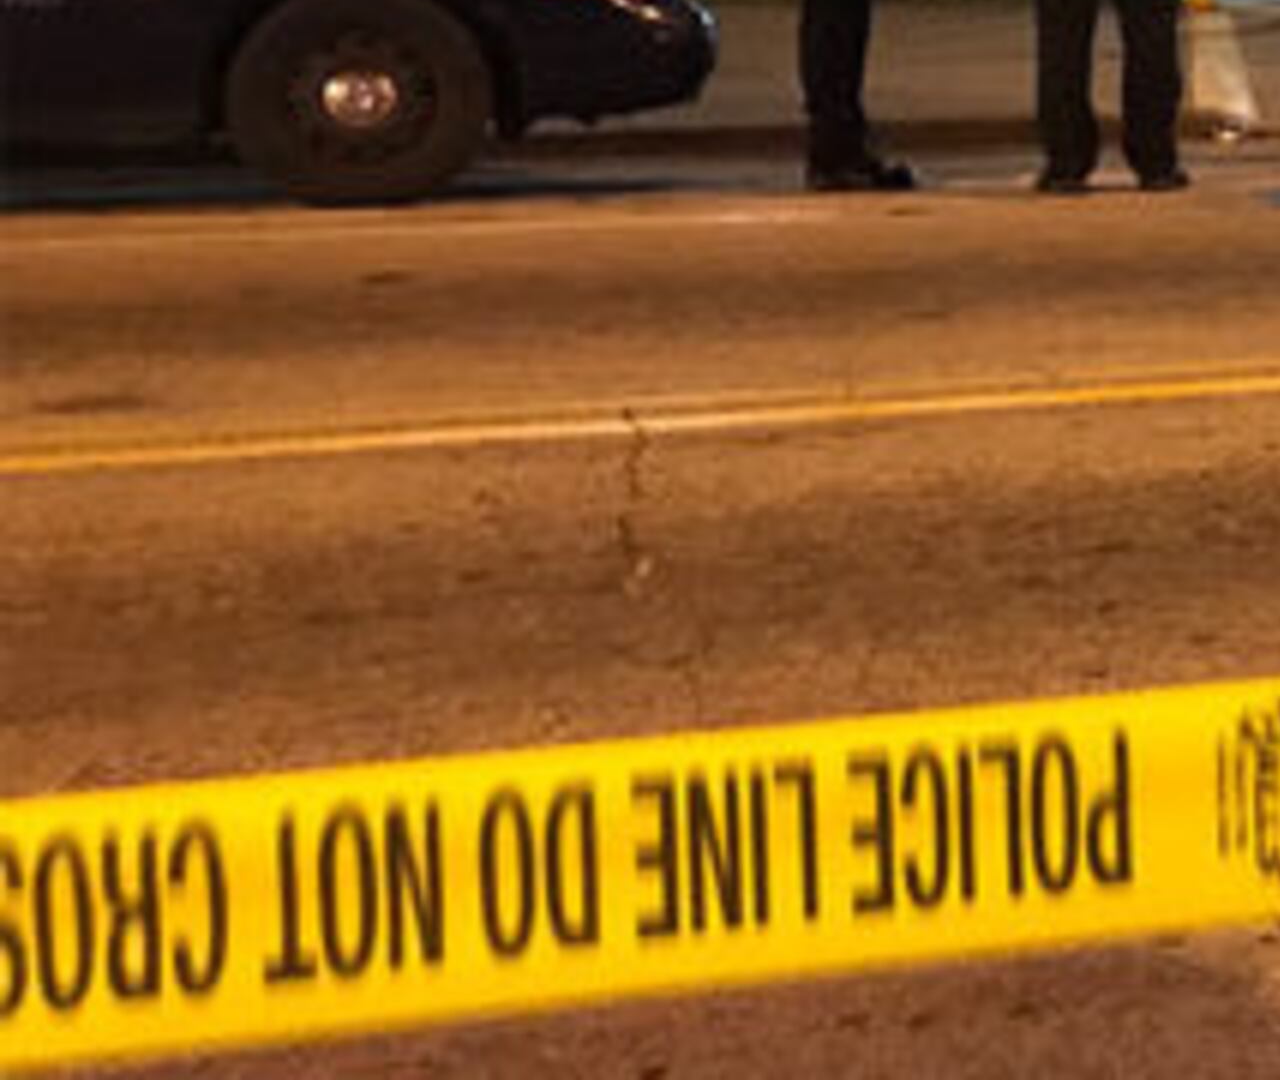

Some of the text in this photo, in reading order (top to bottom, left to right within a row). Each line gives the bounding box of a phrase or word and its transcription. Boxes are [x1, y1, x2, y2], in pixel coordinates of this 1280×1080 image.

[262, 798, 446, 988] NOT
[477, 782, 602, 962] DO
[629, 760, 822, 944] LINE
[846, 727, 1136, 918] POLICE
